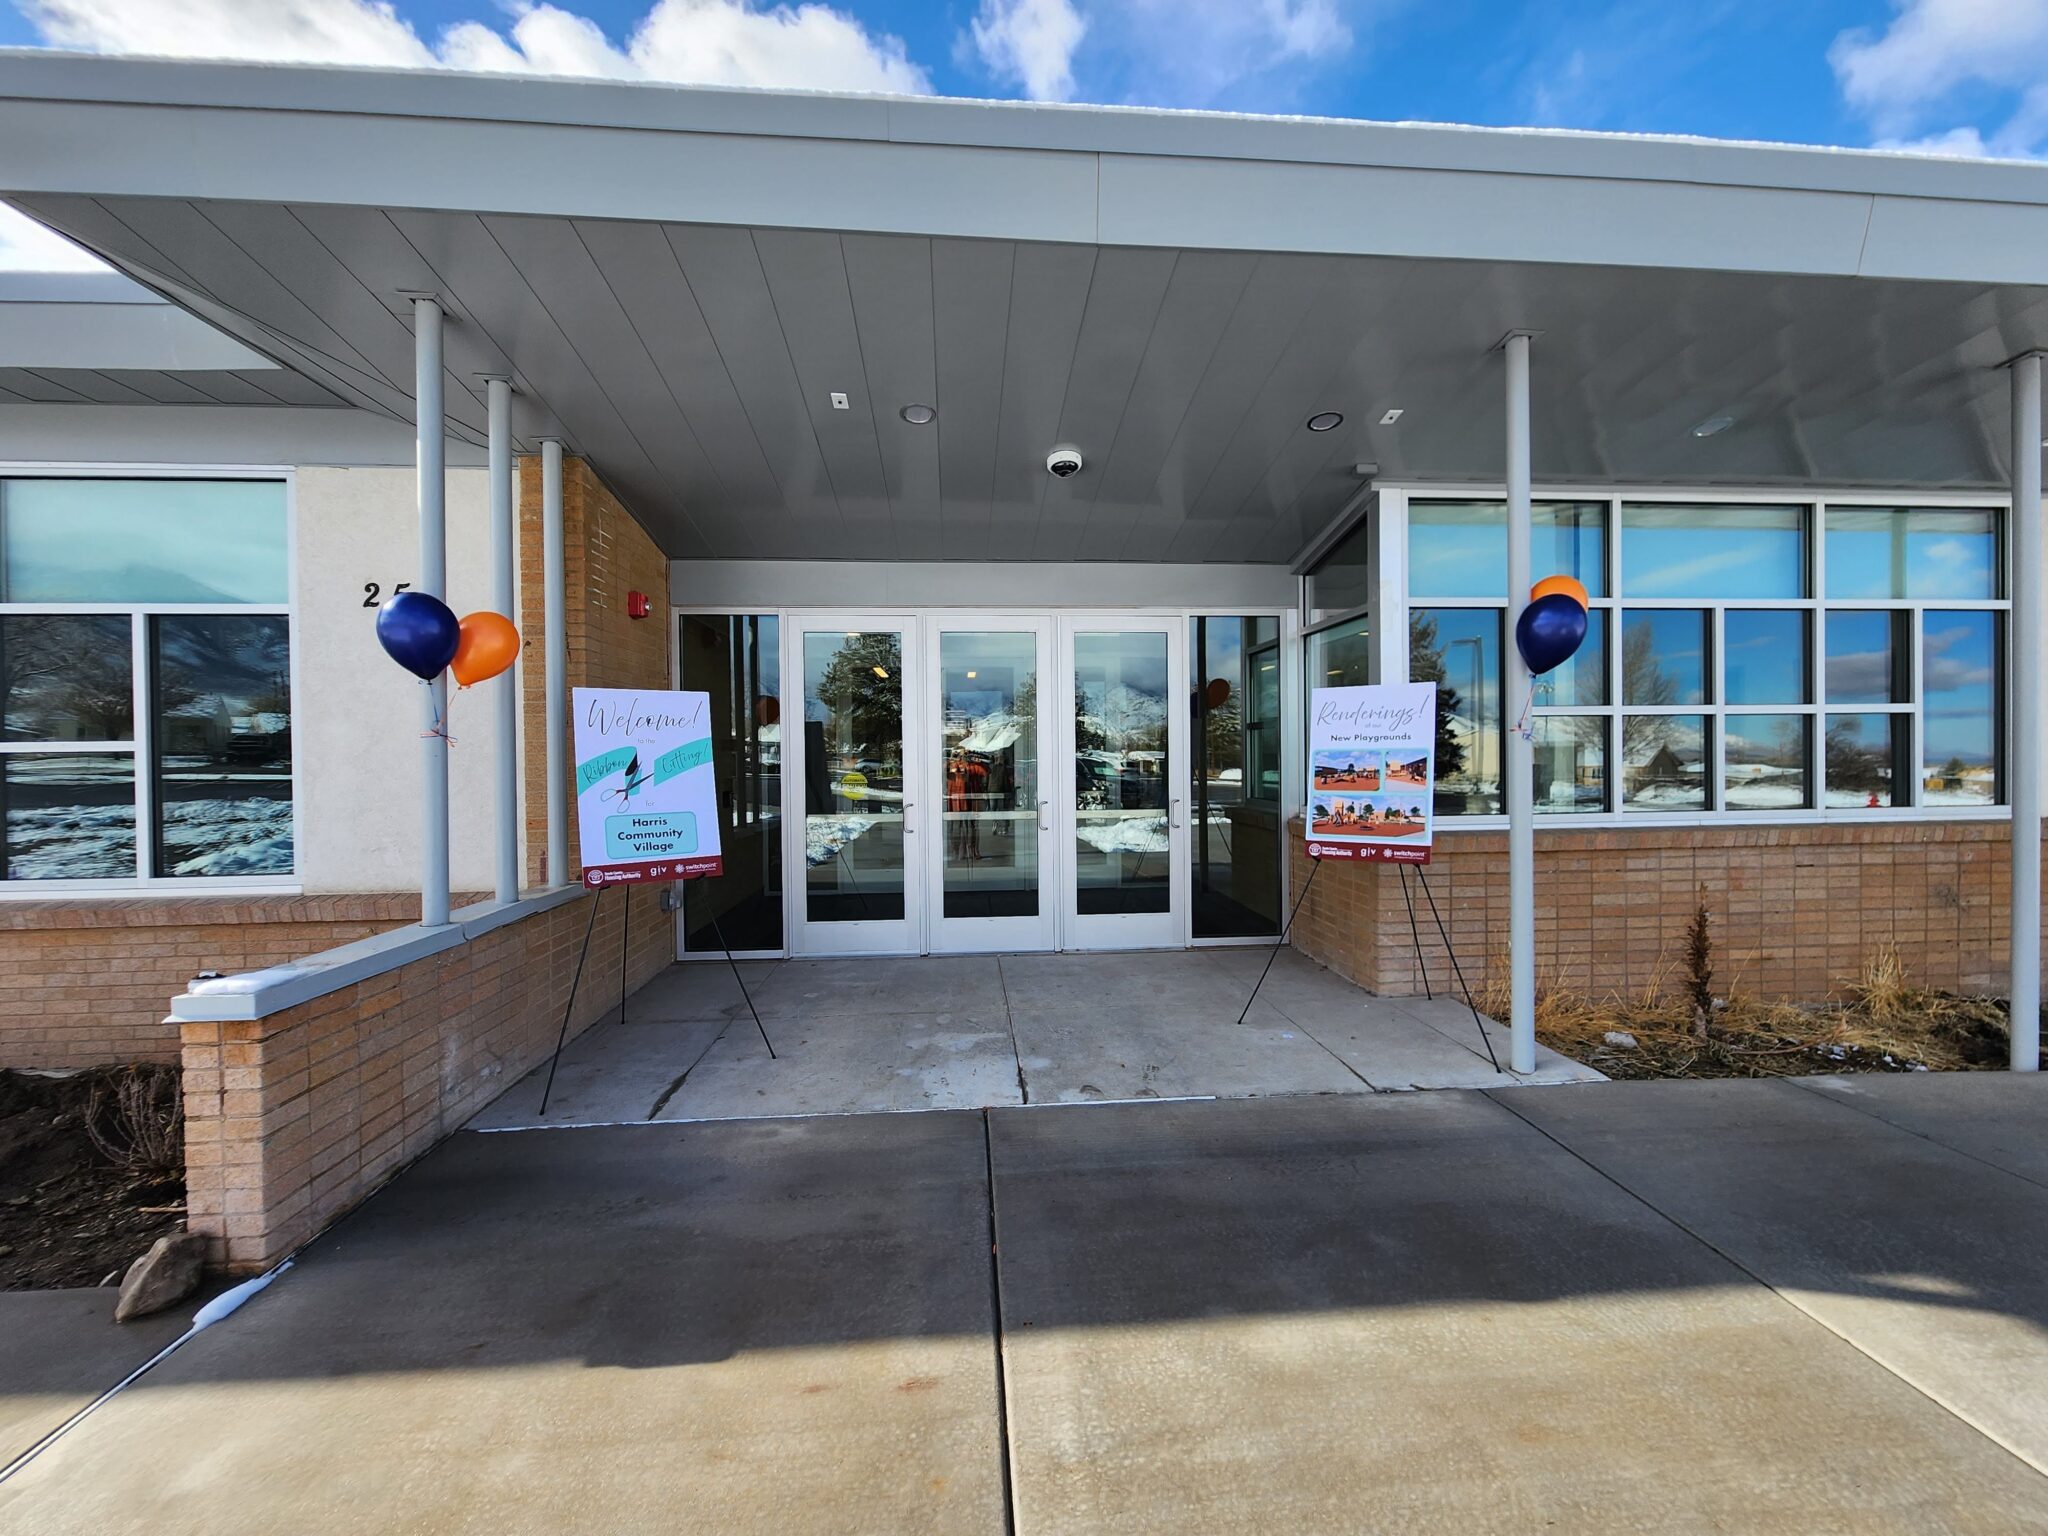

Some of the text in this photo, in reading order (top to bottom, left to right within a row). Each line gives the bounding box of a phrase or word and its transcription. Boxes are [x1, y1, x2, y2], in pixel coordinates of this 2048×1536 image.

[588, 698, 703, 736] Welcome!
[1317, 694, 1430, 731] Renderings!
[1354, 733, 1412, 743] Playgrounds
[583, 757, 627, 784] Ribbon
[632, 817, 668, 827] Harris
[617, 828, 683, 841] Community
[633, 842, 674, 852] Village
